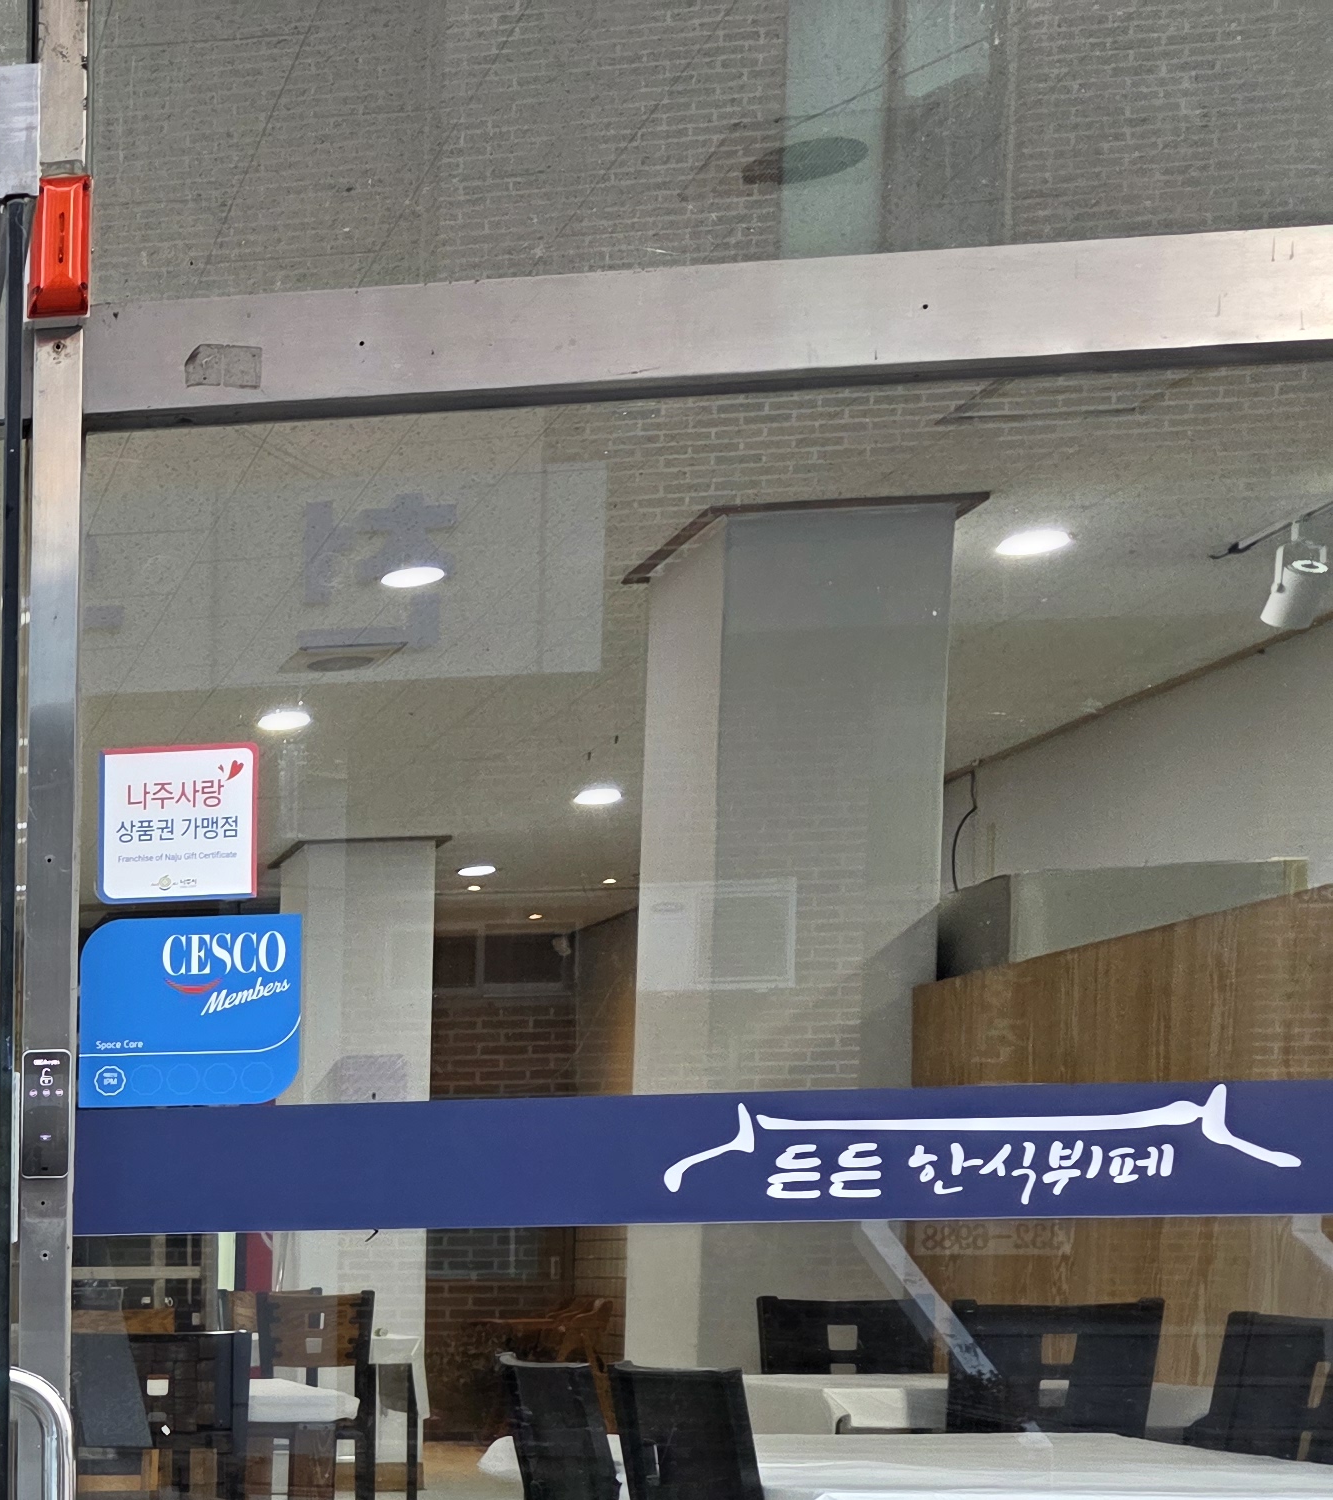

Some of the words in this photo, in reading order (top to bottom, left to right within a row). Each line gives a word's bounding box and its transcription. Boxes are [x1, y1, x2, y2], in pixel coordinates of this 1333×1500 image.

[127, 778, 225, 811] 나주사랑
[116, 818, 175, 844] 상품권
[180, 815, 239, 840] 가맹점
[118, 855, 154, 864] Franchise
[155, 853, 163, 862] of
[165, 853, 182, 863] Naju
[184, 852, 197, 861] Gift
[199, 850, 238, 860] Certificate
[162, 930, 287, 977] CESCO
[200, 976, 291, 1016] Members
[95, 1040, 122, 1051] Space
[123, 1039, 144, 1049] Care
[766, 1142, 883, 1199] 든든
[908, 1140, 1175, 1205] 한식뷔페
